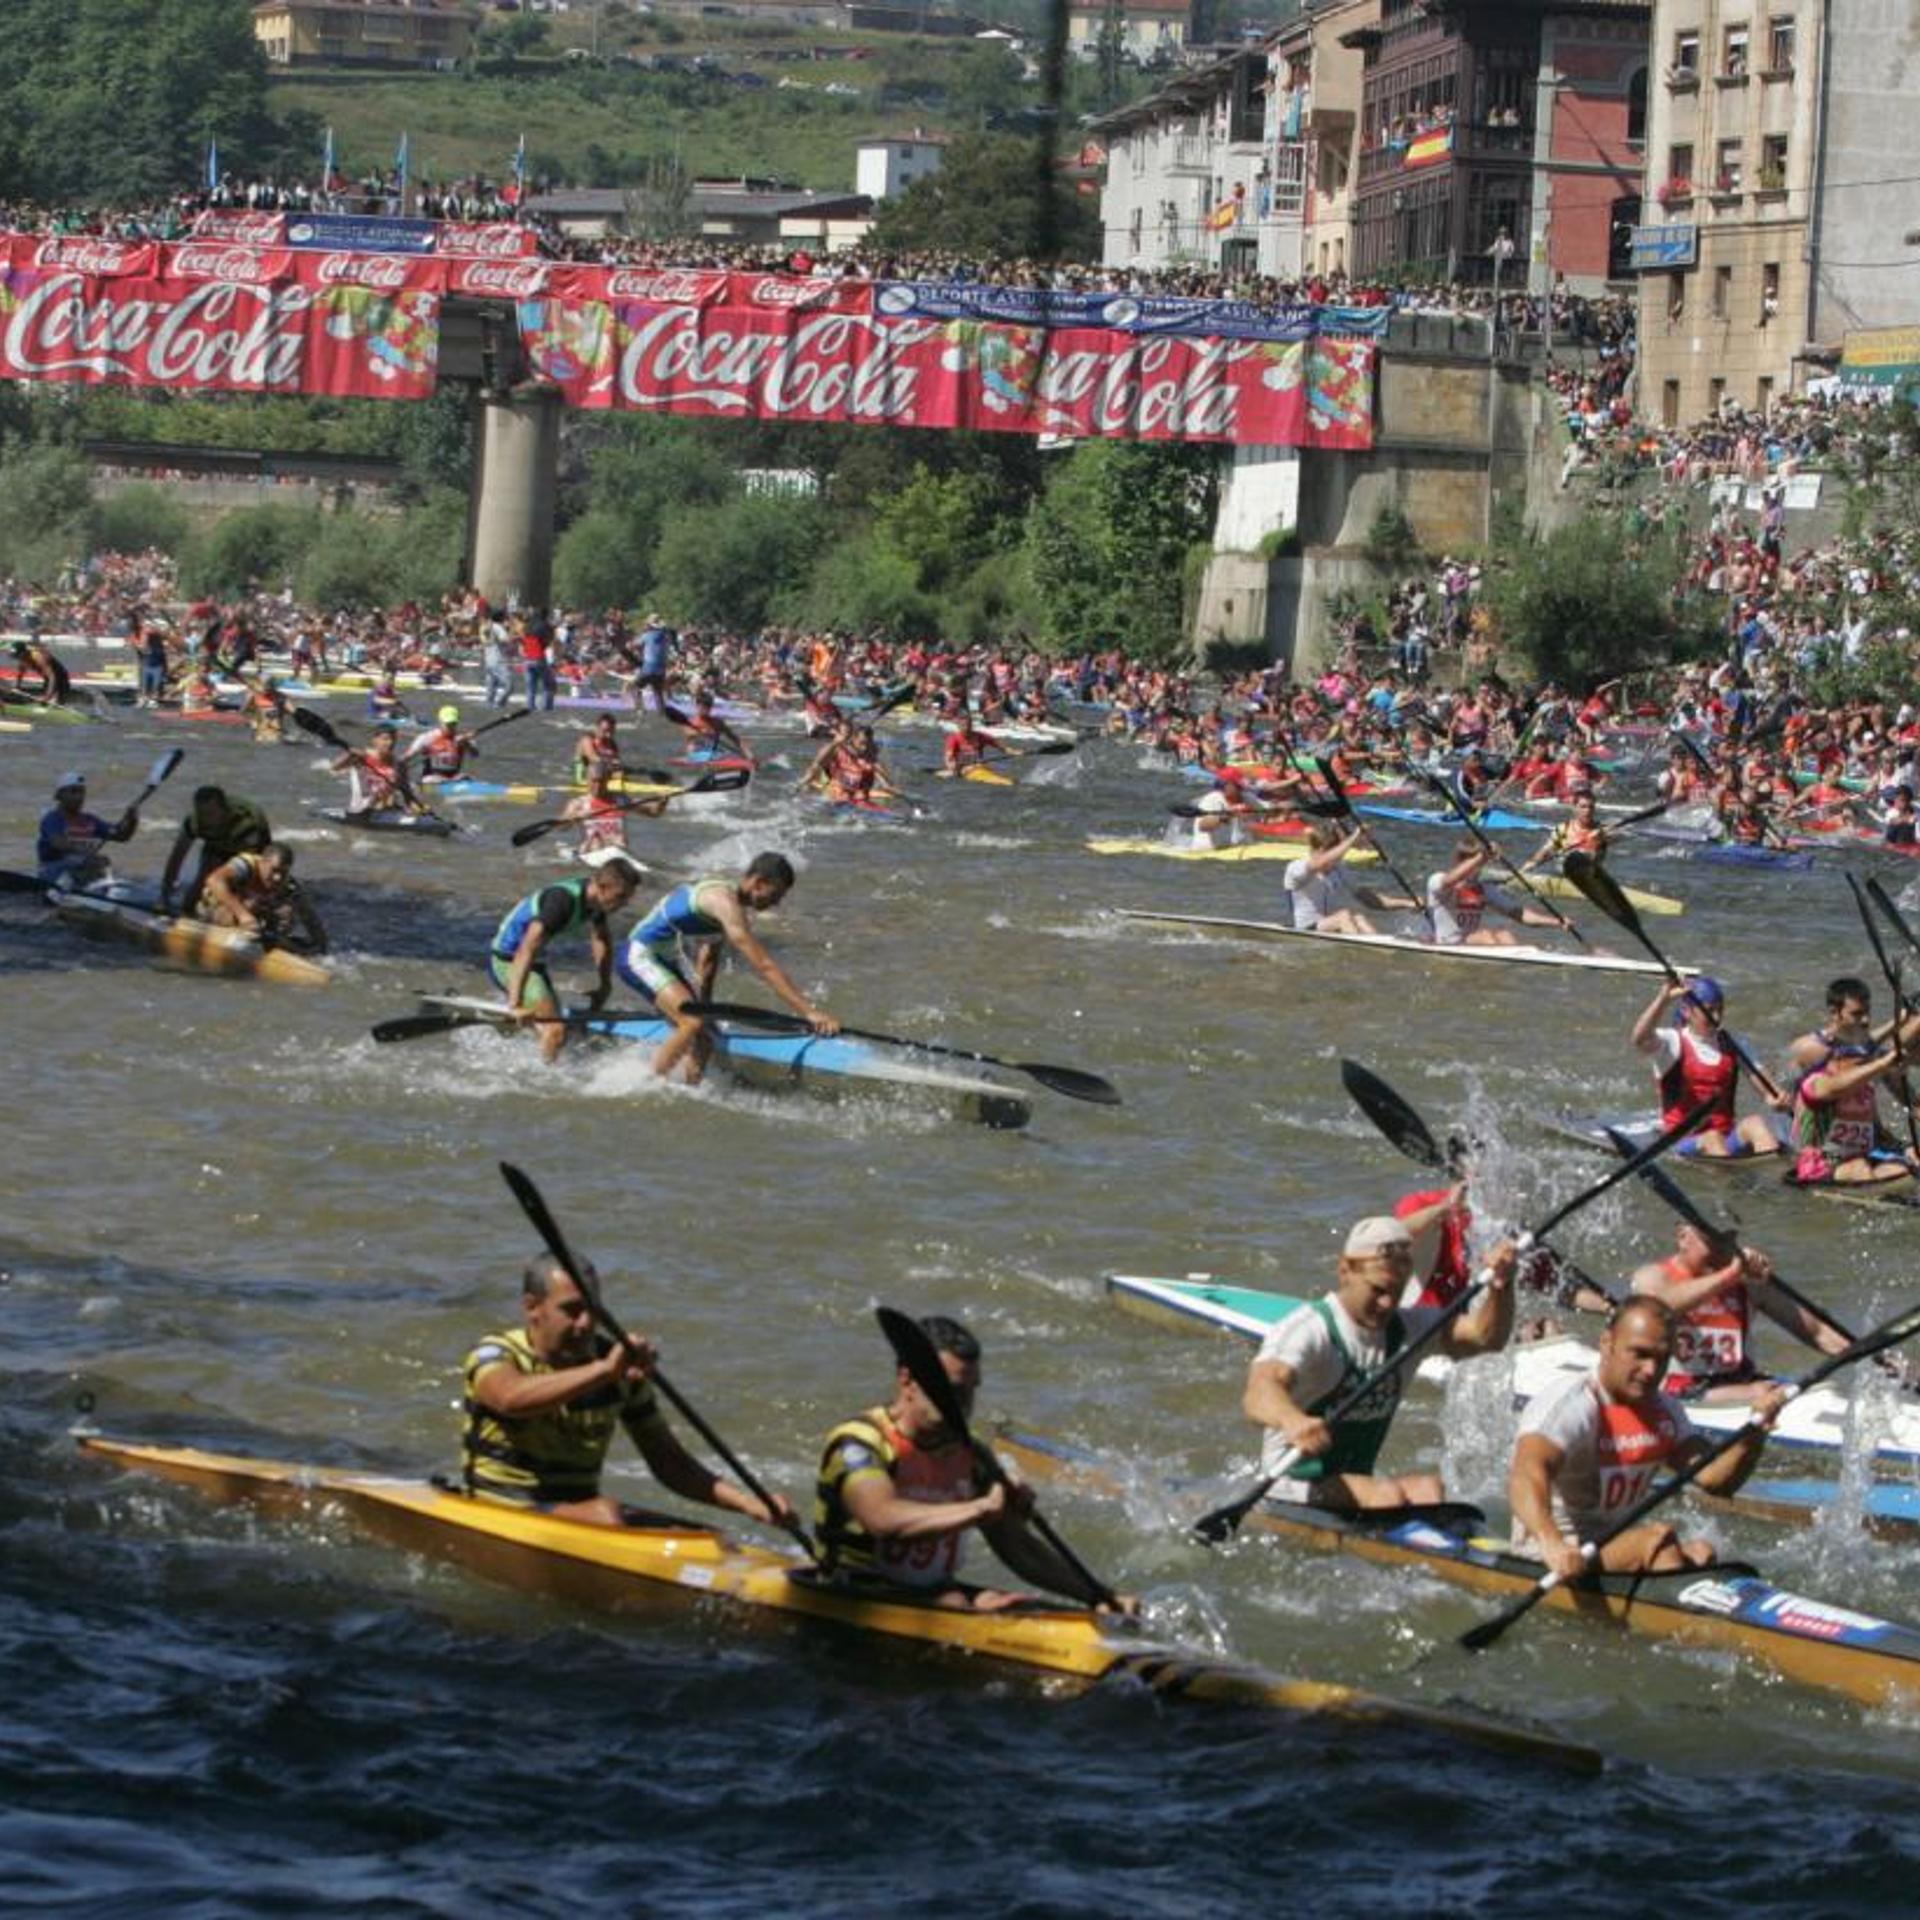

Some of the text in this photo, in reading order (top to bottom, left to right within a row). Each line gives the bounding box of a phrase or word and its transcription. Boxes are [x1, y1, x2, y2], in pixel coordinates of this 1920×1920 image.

[172, 246, 262, 280] Coca-Cola
[919, 287, 1088, 307] DEPORTE ASTUANO
[6, 273, 308, 386] Coca-Cola
[620, 304, 938, 417] Coca-Cola
